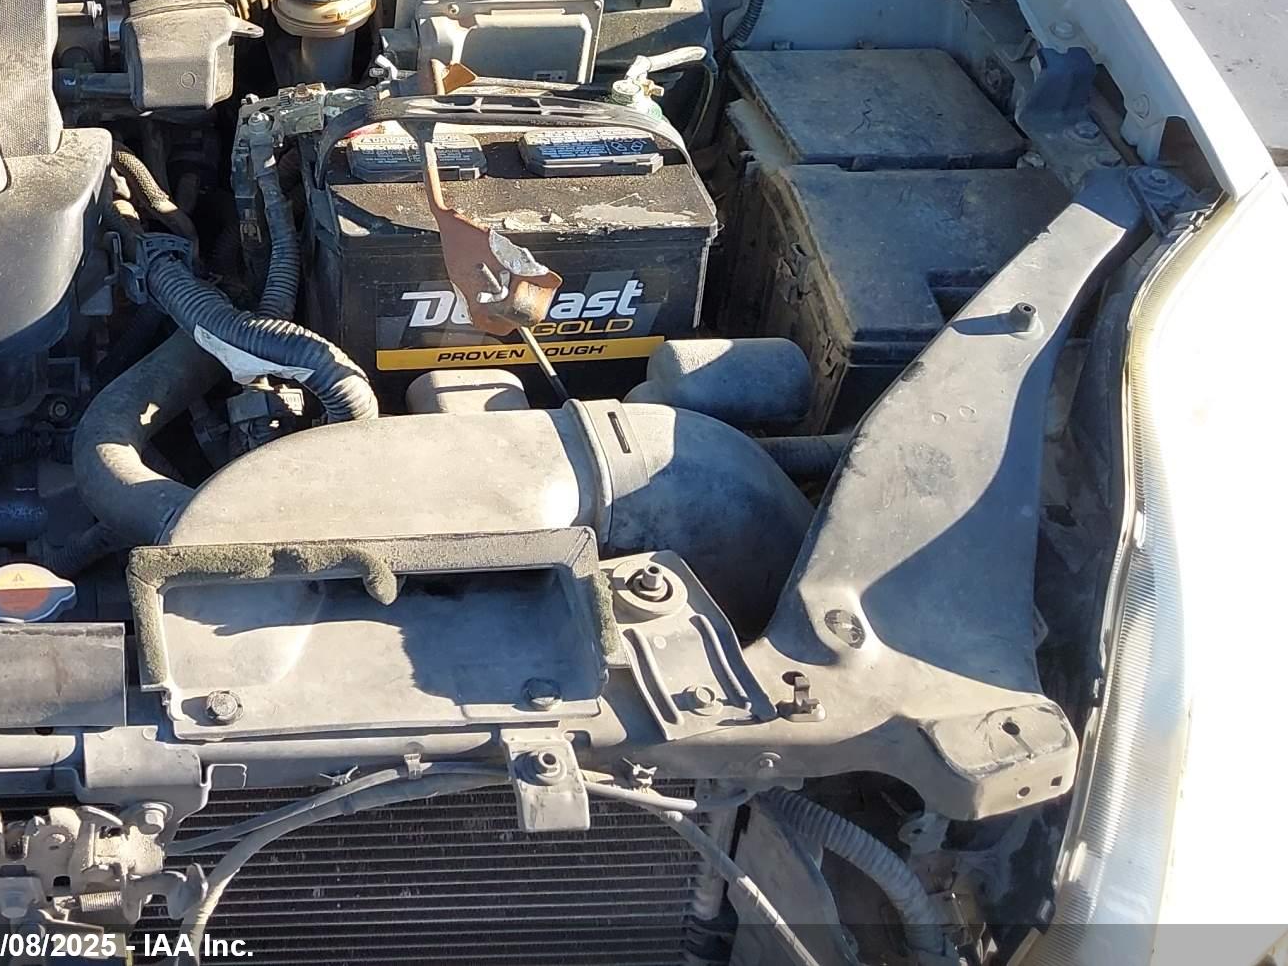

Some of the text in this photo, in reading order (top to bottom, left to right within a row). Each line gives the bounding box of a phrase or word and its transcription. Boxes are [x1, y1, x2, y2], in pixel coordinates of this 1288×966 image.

[530, 318, 634, 336] GOLD
[437, 345, 605, 363] PROVEN OUGH
